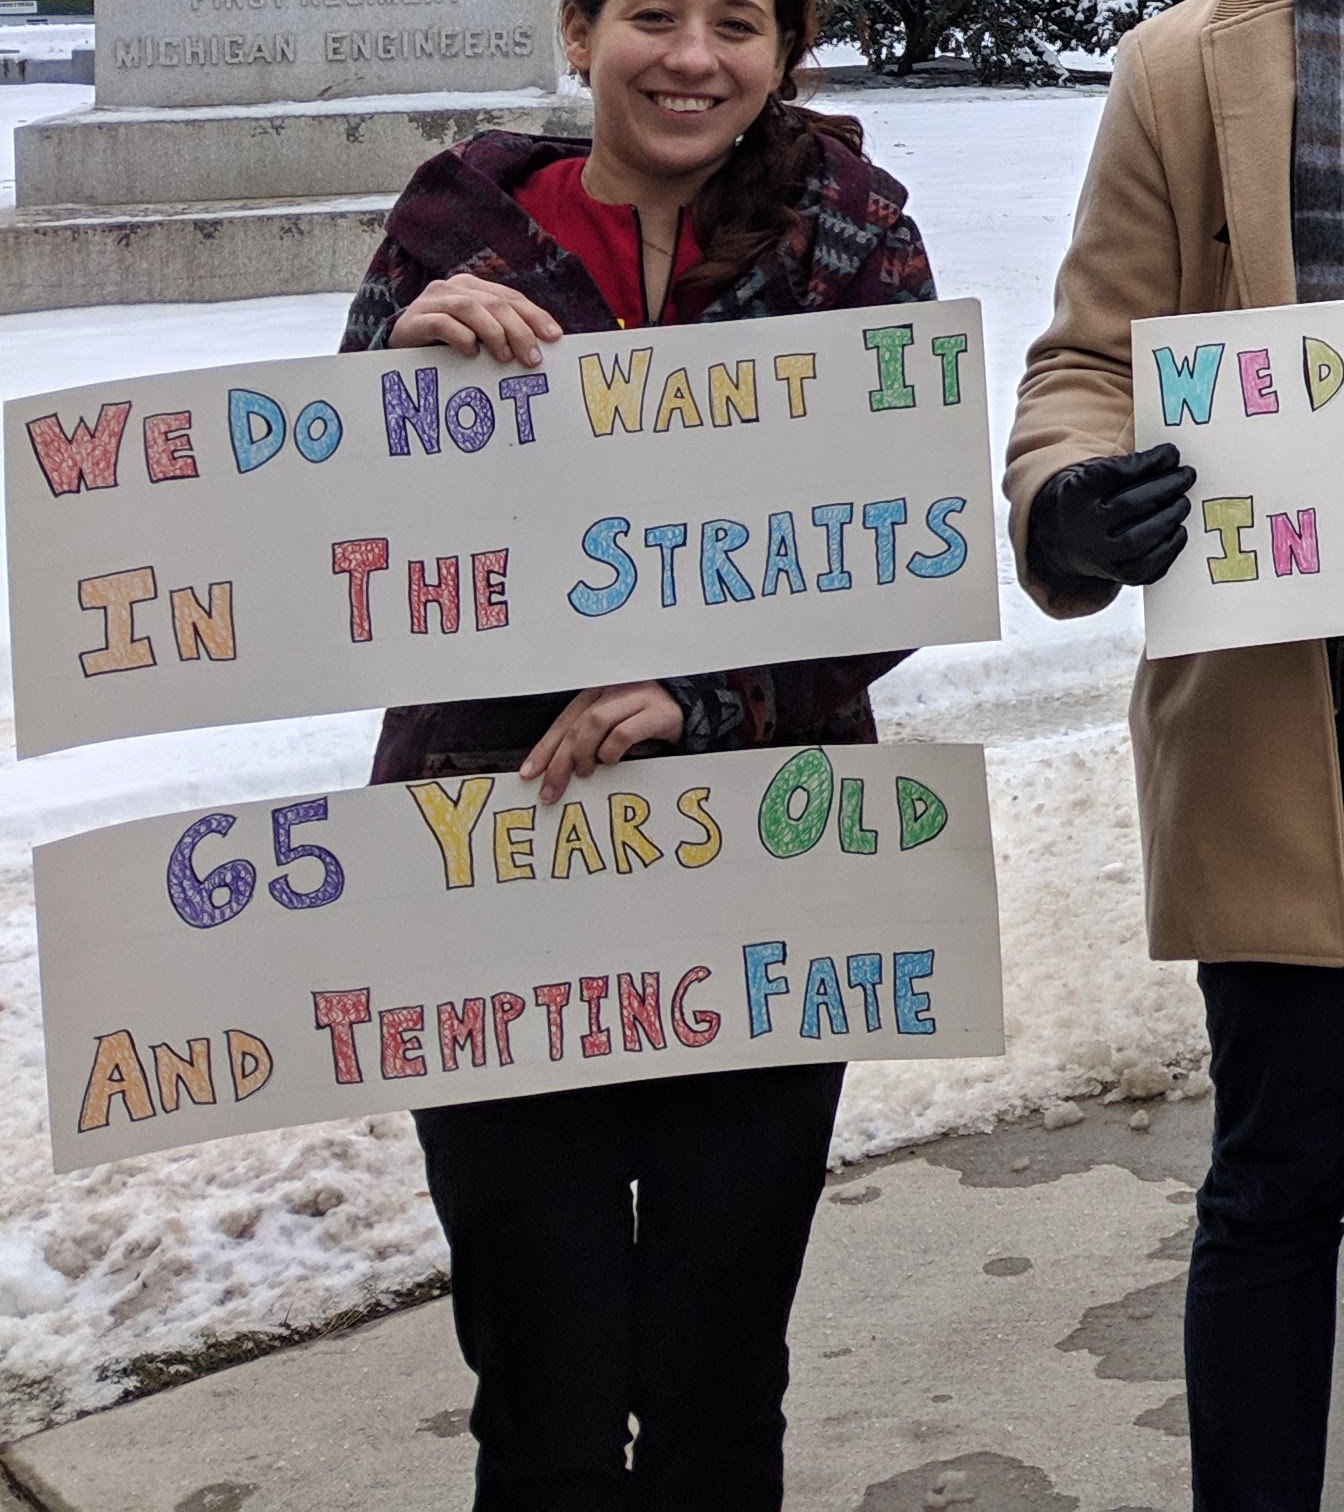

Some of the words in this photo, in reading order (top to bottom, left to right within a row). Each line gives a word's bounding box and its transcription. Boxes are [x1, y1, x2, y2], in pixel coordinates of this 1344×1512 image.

[115, 31, 296, 67] MICHIGAN
[325, 26, 535, 62] ENGINEERS
[25, 401, 200, 498] WE
[228, 389, 343, 474] DO
[382, 367, 549, 456] NOT
[579, 347, 816, 437] WANT
[863, 324, 967, 411] IT
[1152, 343, 1279, 426] WE
[78, 566, 236, 677] IN
[332, 538, 509, 642] THE
[567, 497, 967, 617] STRAITS
[1202, 495, 1320, 584] IN
[167, 796, 345, 928] 65
[405, 777, 722, 890] YEARS
[758, 746, 948, 859] OLD
[78, 1029, 274, 1133] AND
[311, 966, 720, 1084] TEMPTING
[743, 941, 936, 1039] FATE
